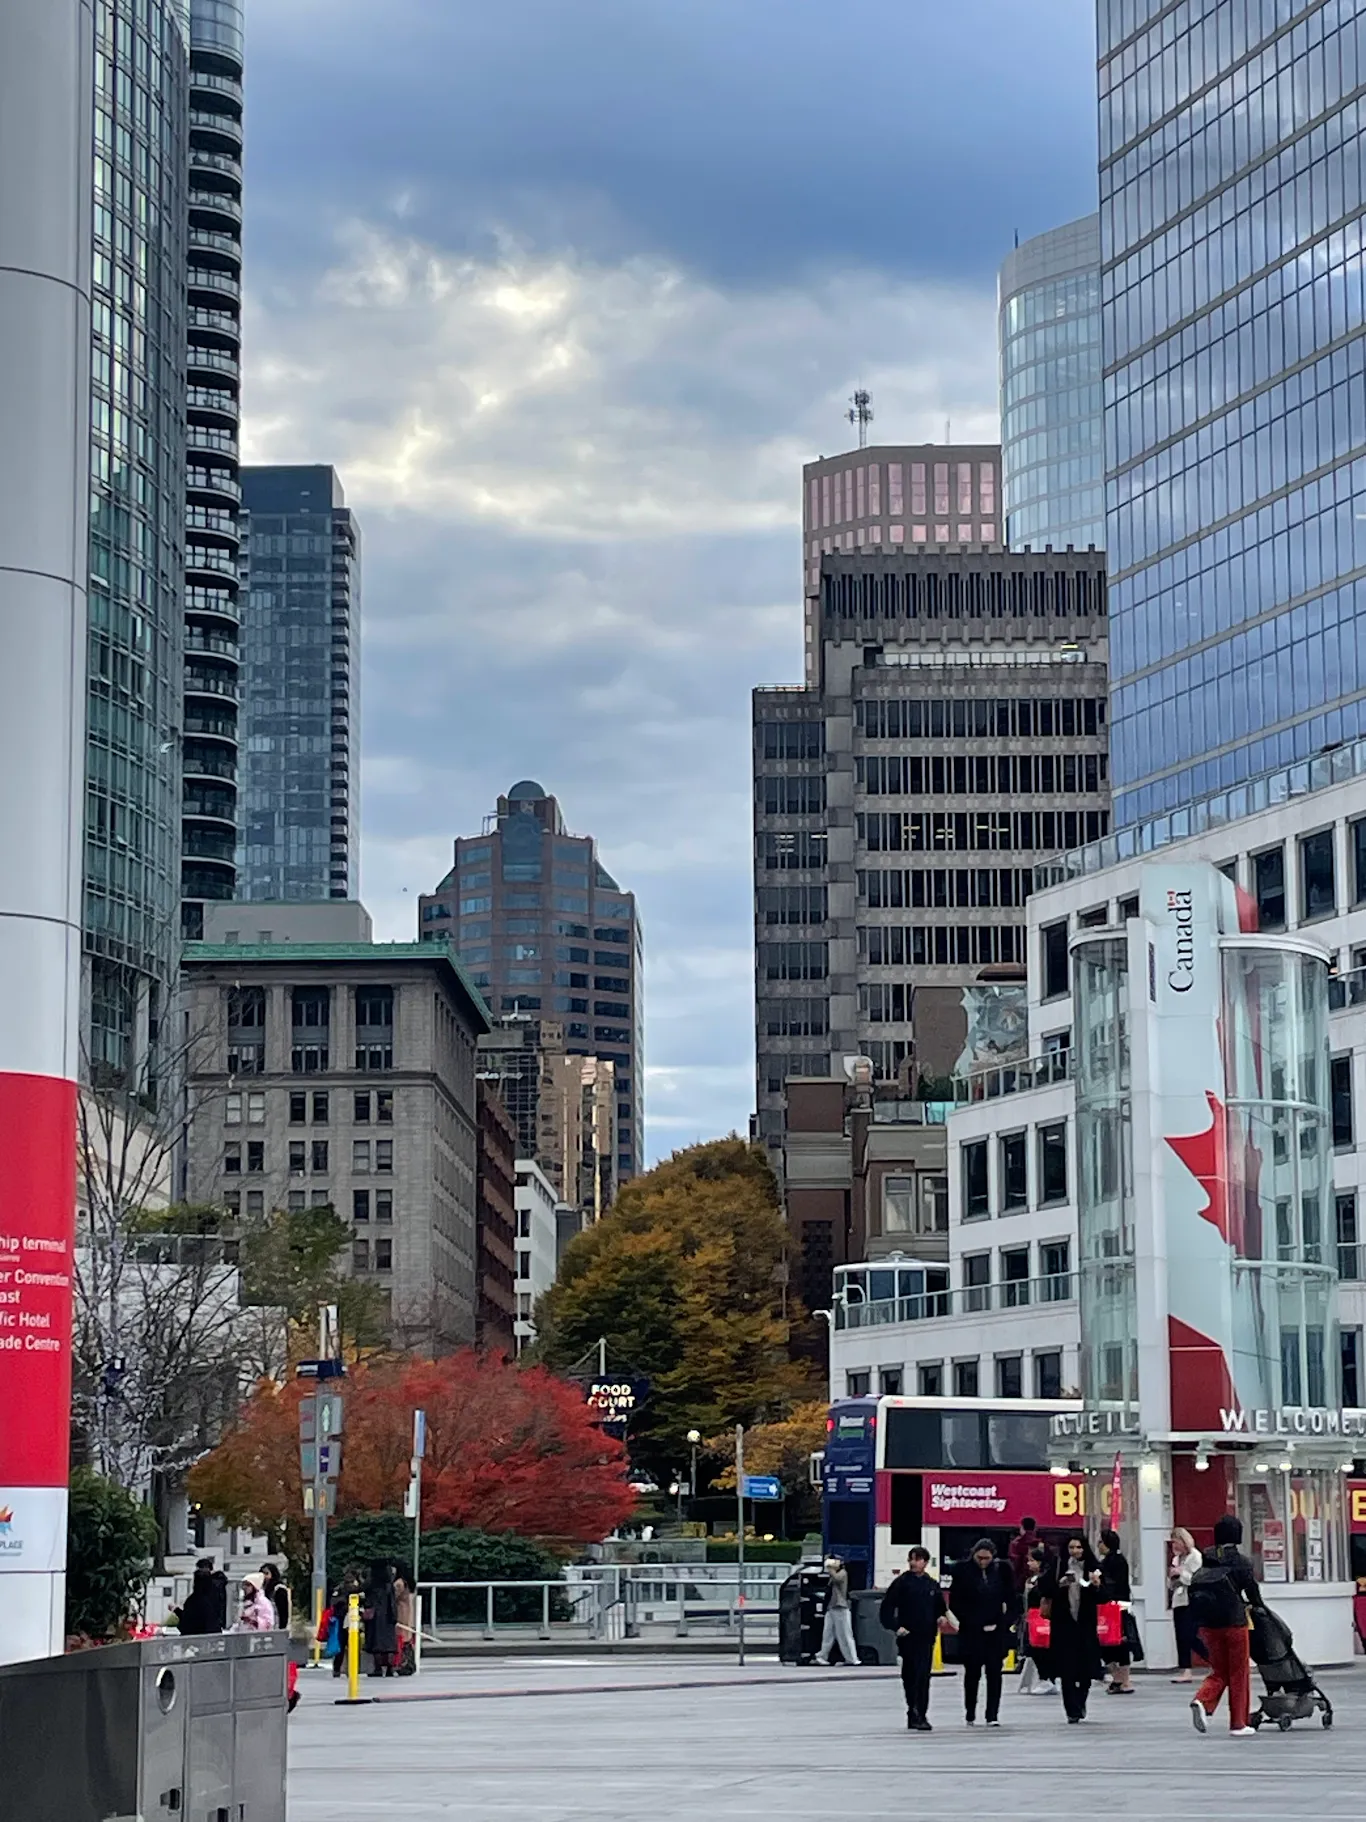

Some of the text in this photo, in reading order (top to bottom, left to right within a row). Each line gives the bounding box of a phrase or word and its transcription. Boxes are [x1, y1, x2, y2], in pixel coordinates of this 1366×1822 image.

[1167, 889, 1194, 993] Canada
[22, 1236, 66, 1253] terminal
[19, 1312, 50, 1328] Hotel
[25, 1335, 60, 1352] Centre
[592, 1384, 631, 1396] FOOD
[587, 1396, 635, 1408] COURT
[1219, 1407, 1351, 1434] WELCOME
[931, 1484, 997, 1497] Westcoast
[931, 1495, 1007, 1512] Sightseeing
